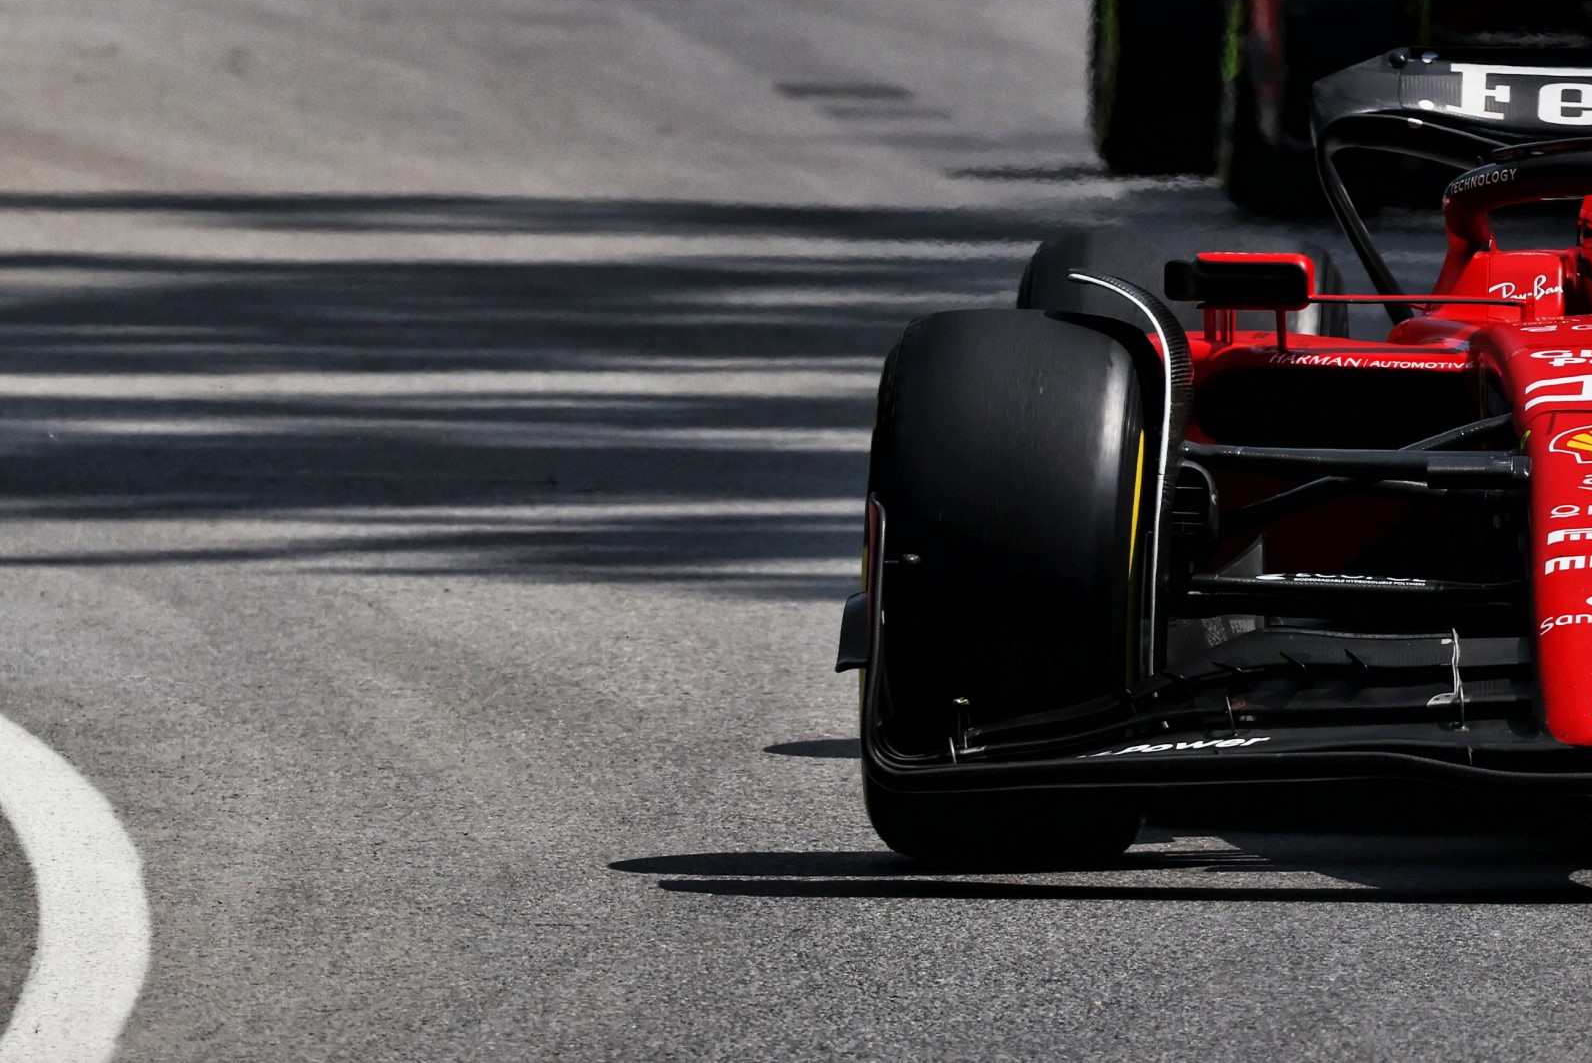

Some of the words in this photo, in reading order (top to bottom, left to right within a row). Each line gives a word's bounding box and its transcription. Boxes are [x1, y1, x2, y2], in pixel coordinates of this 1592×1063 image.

[1450, 168, 1517, 194] TECHNOLOGY
[1268, 352, 1362, 368] HARMAN
[1369, 360, 1474, 369] AUTOMOTIVE
